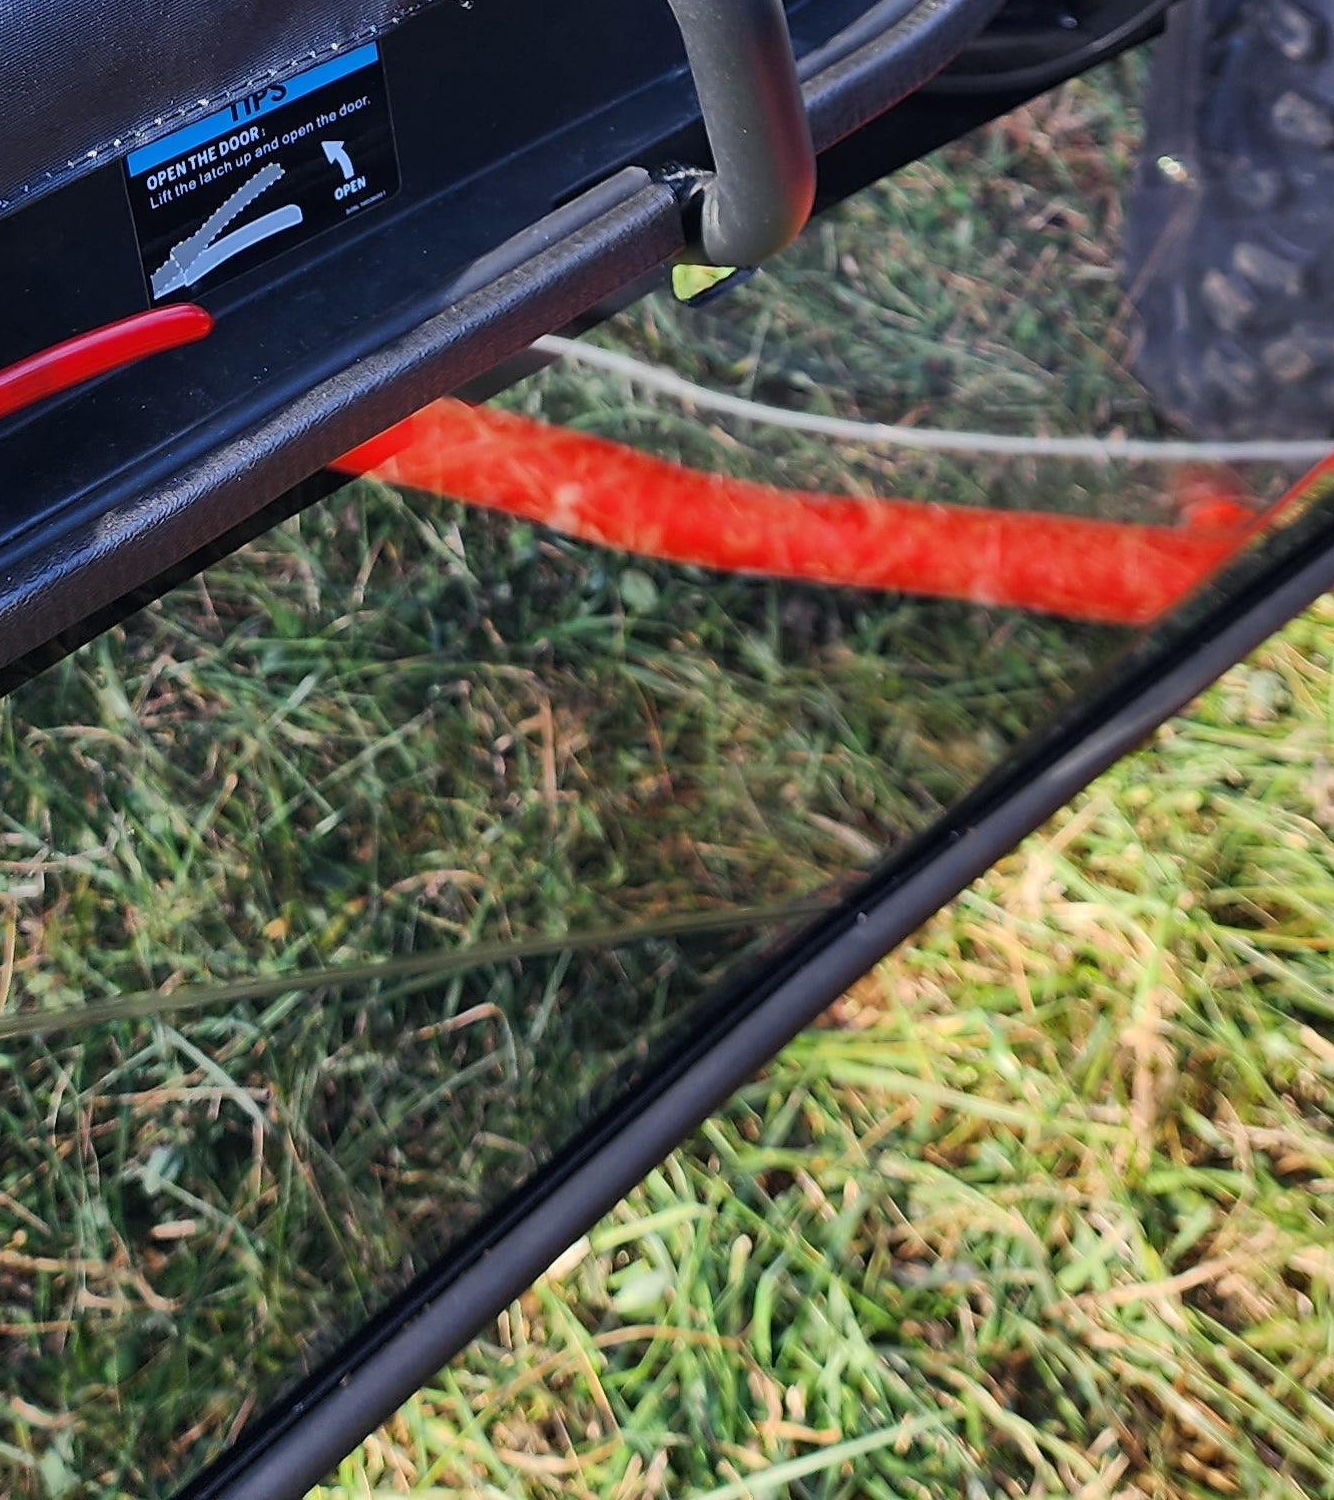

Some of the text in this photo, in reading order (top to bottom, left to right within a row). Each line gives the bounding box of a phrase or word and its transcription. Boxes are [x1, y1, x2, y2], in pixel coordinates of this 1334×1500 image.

[147, 161, 187, 190] OPEN
[188, 146, 217, 170] THE
[150, 96, 371, 209] Lift the latch up and open the door.
[334, 176, 366, 200] OPEN
